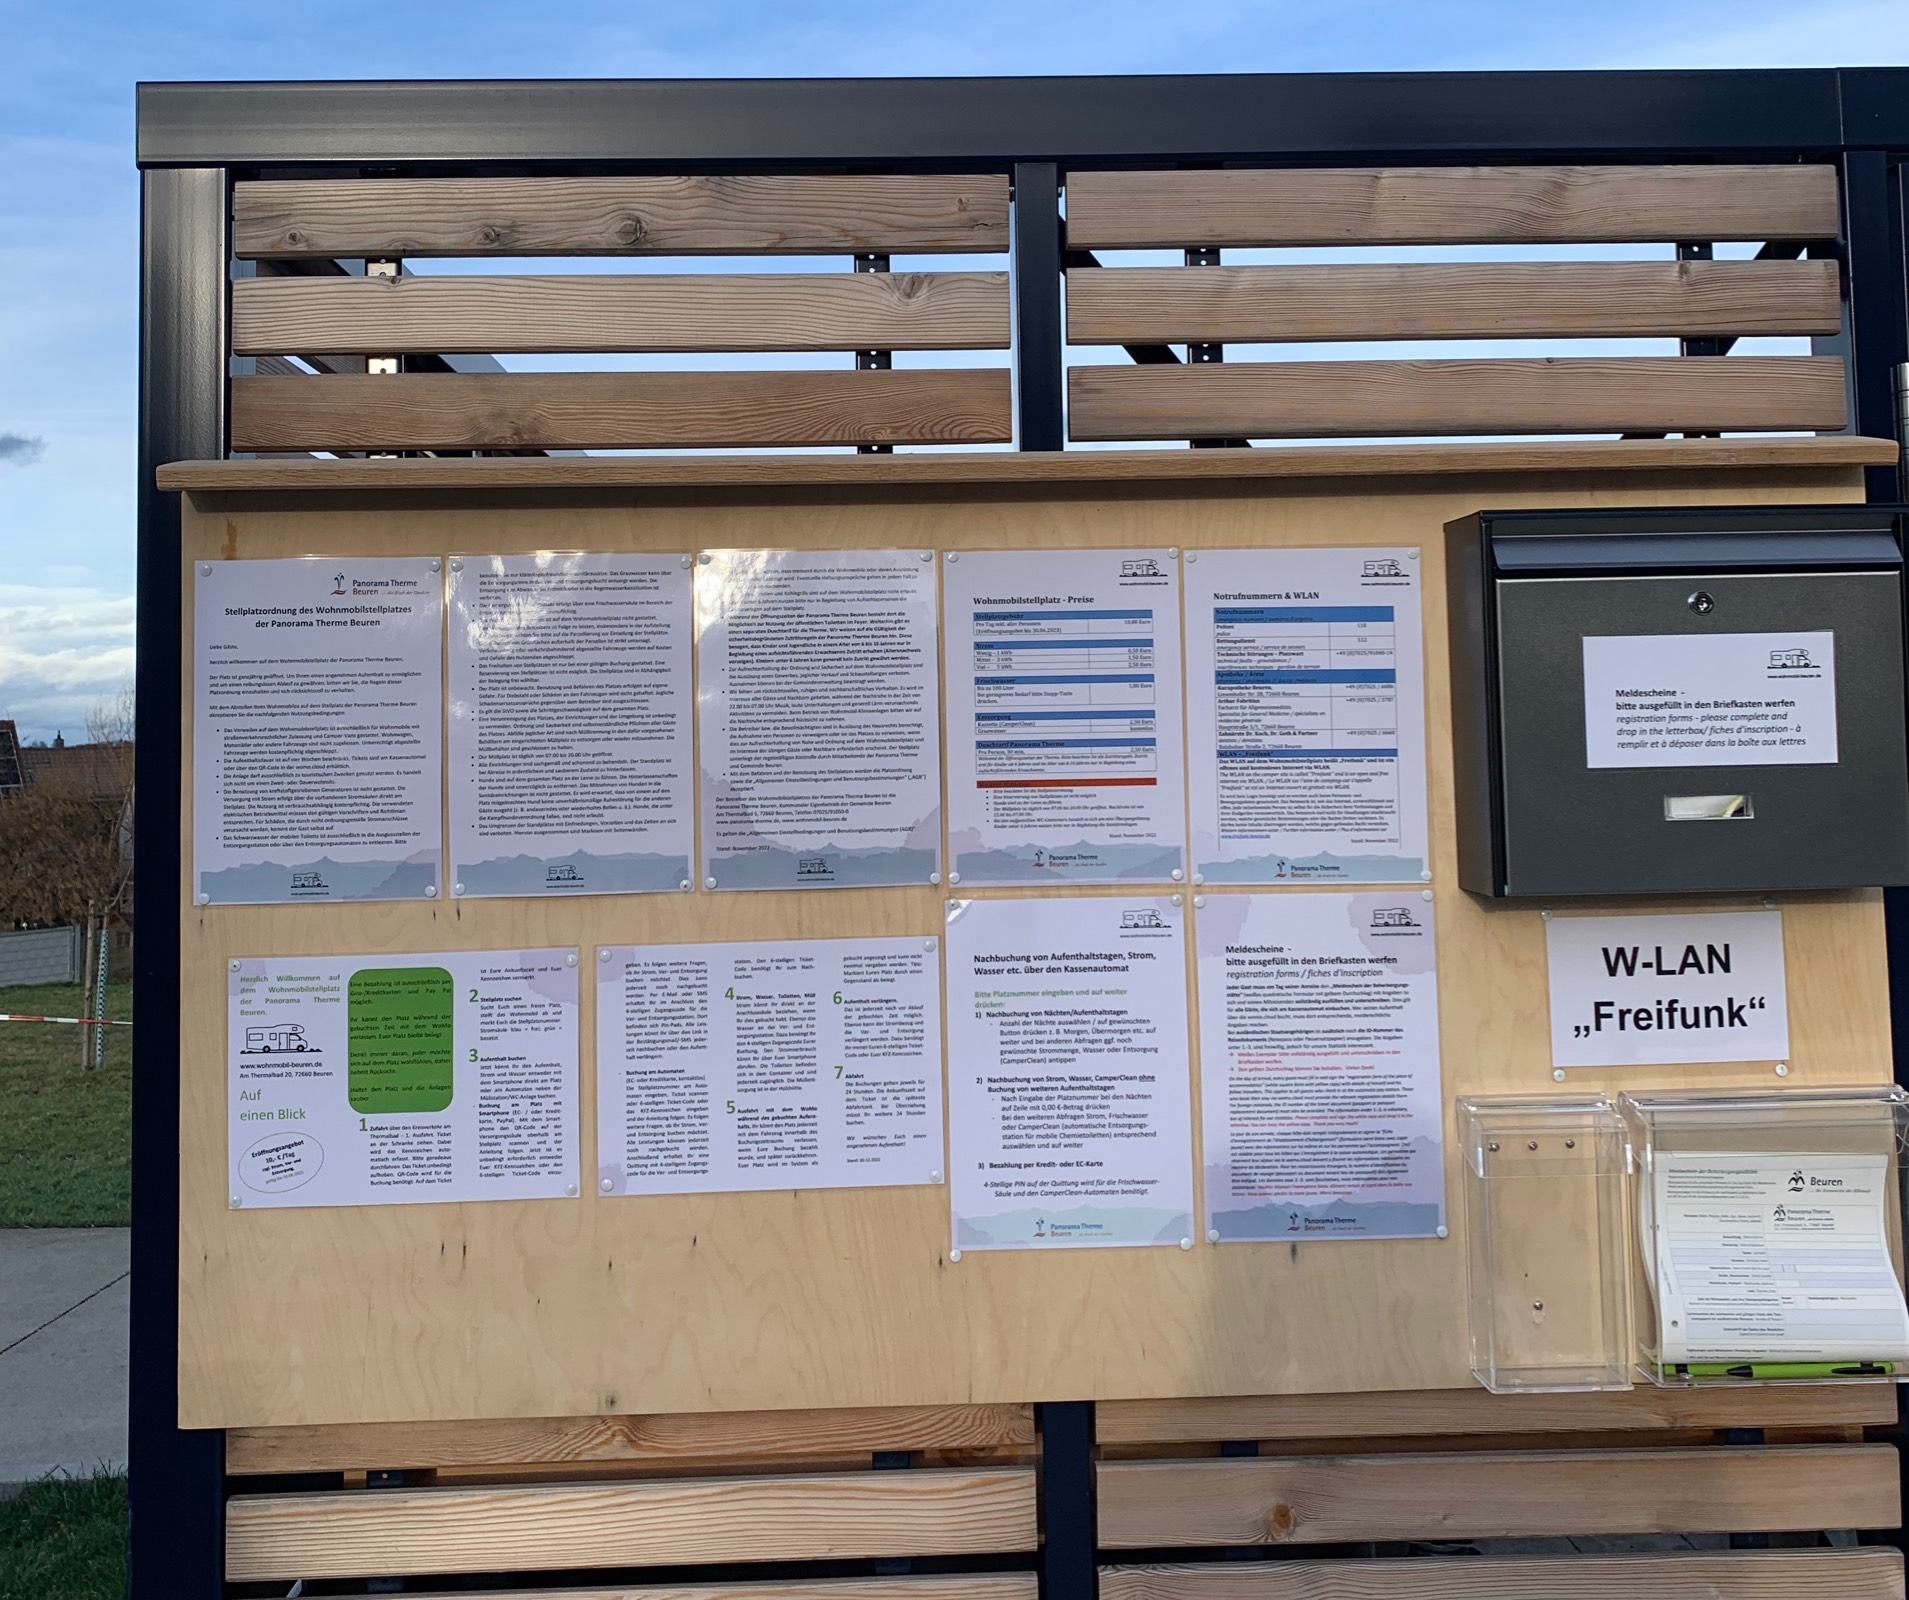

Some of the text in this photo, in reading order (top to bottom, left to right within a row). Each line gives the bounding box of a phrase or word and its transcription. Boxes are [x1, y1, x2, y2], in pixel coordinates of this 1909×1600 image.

[352, 579, 389, 588] Panorama
[352, 587, 378, 595] Beuren
[1293, 591, 1318, 599] WLAN
[973, 596, 1060, 605] Wohnmobilstellplatz
[224, 605, 411, 616] Stellplatzordnung des Wohnmobilstellplatzes
[271, 619, 313, 627] Panorama
[350, 618, 380, 626] Beuren
[1616, 688, 1676, 697] Meldescheine
[1616, 702, 1636, 710] bitte
[1639, 701, 1681, 711] ausgefüllt
[1694, 700, 1710, 708] den
[1713, 699, 1762, 708] Briefkasten
[1764, 698, 1794, 707] werfen
[1616, 714, 1666, 724] registration
[1668, 713, 1692, 723] forms
[1700, 713, 1728, 722] please
[1730, 712, 1768, 722] complete
[1771, 712, 1787, 720] and
[1616, 727, 1636, 736] drop
[1649, 727, 1663, 735] the
[1666, 726, 1708, 735] letterbox/
[1708, 725, 1733, 735] fiches
[1736, 725, 1787, 734] d'inscription
[1795, 724, 1800, 732] à
[1617, 740, 1648, 749] remplir
[1669, 739, 1702, 749] déposer
[1705, 738, 1725, 746] dans
[1728, 738, 1735, 746] la
[1738, 737, 1759, 746] boîte
[1779, 737, 1805, 745] lettres
[1225, 944, 1283, 953] Meldescheine
[974, 953, 1031, 964] Nachbuchung
[1050, 951, 1125, 962] Aufenthaltstagen,
[1127, 951, 1156, 960] Strom,
[1226, 957, 1245, 965] bitte
[1248, 957, 1288, 967] ausgefüllt
[1319, 956, 1365, 964] Briefkasten
[1368, 955, 1397, 963] werfen
[1601, 943, 1730, 976] W-LAN
[974, 967, 1004, 975] Wasser
[1024, 965, 1043, 973] über
[1045, 965, 1061, 973] den
[1064, 964, 1128, 972] Kassenautomat
[1226, 970, 1274, 980] registration
[1275, 969, 1299, 979] forms
[1307, 968, 1330, 978] fiches
[1333, 968, 1382, 978] d'inscription
[240, 975, 268, 984] Herzlich
[239, 985, 339, 994] dem Wohnmobilstellplatz
[469, 989, 478, 1002] 2
[724, 987, 734, 1000] 4
[1041, 988, 1073, 997] eingeben
[833, 991, 842, 1004] 6
[986, 1010, 1029, 1018] Nachbuchung
[1044, 1008, 1127, 1017] Nächten/Aufenthaltstagen
[1574, 996, 1765, 1037] „Freifunk“
[469, 1048, 478, 1062] 3
[834, 1065, 843, 1078] 7
[239, 1089, 261, 1100] Auf
[726, 1100, 735, 1113] 5
[239, 1108, 305, 1120] einen Blick
[359, 1118, 367, 1131] 1
[252, 1140, 304, 1158] Eröffnungsangebot
[1810, 1176, 1842, 1186] Beuren
[1304, 1217, 1333, 1225] Panorama
